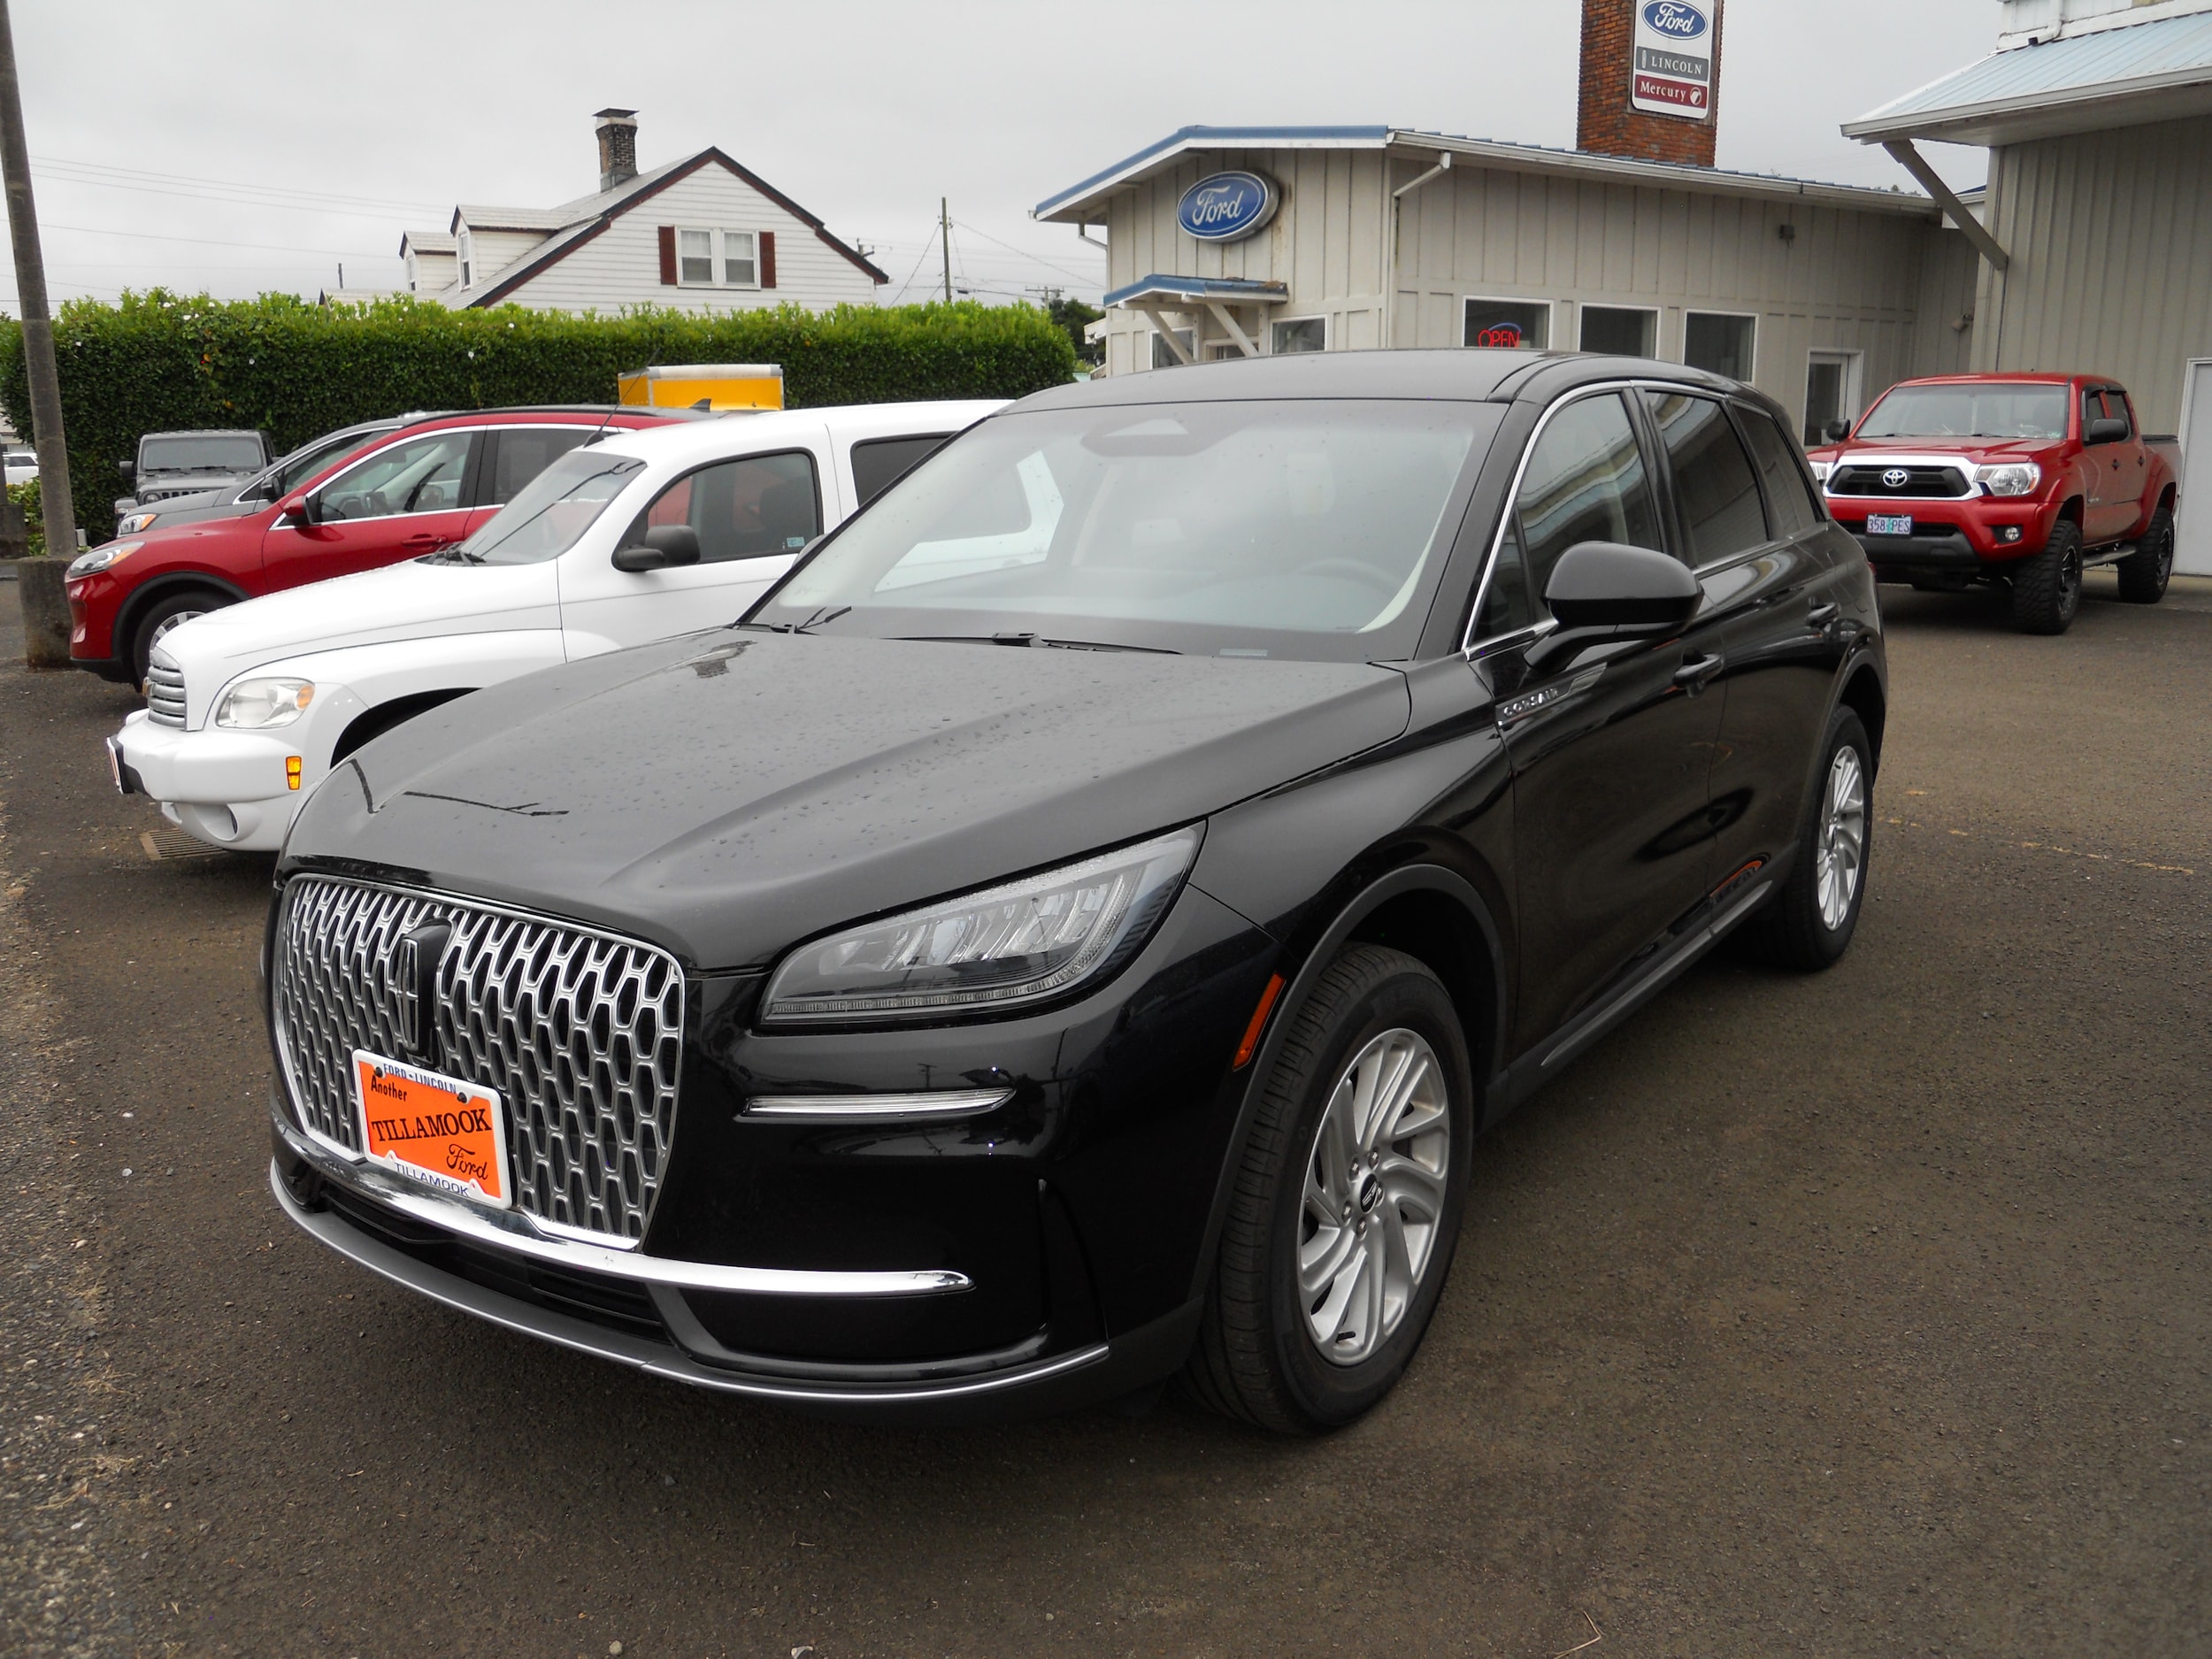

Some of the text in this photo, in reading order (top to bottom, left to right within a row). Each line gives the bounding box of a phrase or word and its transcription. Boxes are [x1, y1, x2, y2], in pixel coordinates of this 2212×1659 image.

[1655, 3, 1695, 33] Ford
[1651, 56, 1702, 75] LINCOLN
[1640, 81, 1686, 102] Mercury
[1192, 185, 1243, 226] Ford
[1869, 518, 1909, 533] 358 PES
[371, 1074, 408, 1102] Another
[383, 1063, 457, 1094] FORD LINCOLN
[371, 1108, 493, 1141] TILLAMOOK
[446, 1143, 489, 1180] Ford
[395, 1163, 470, 1197] TILLAMOOK
